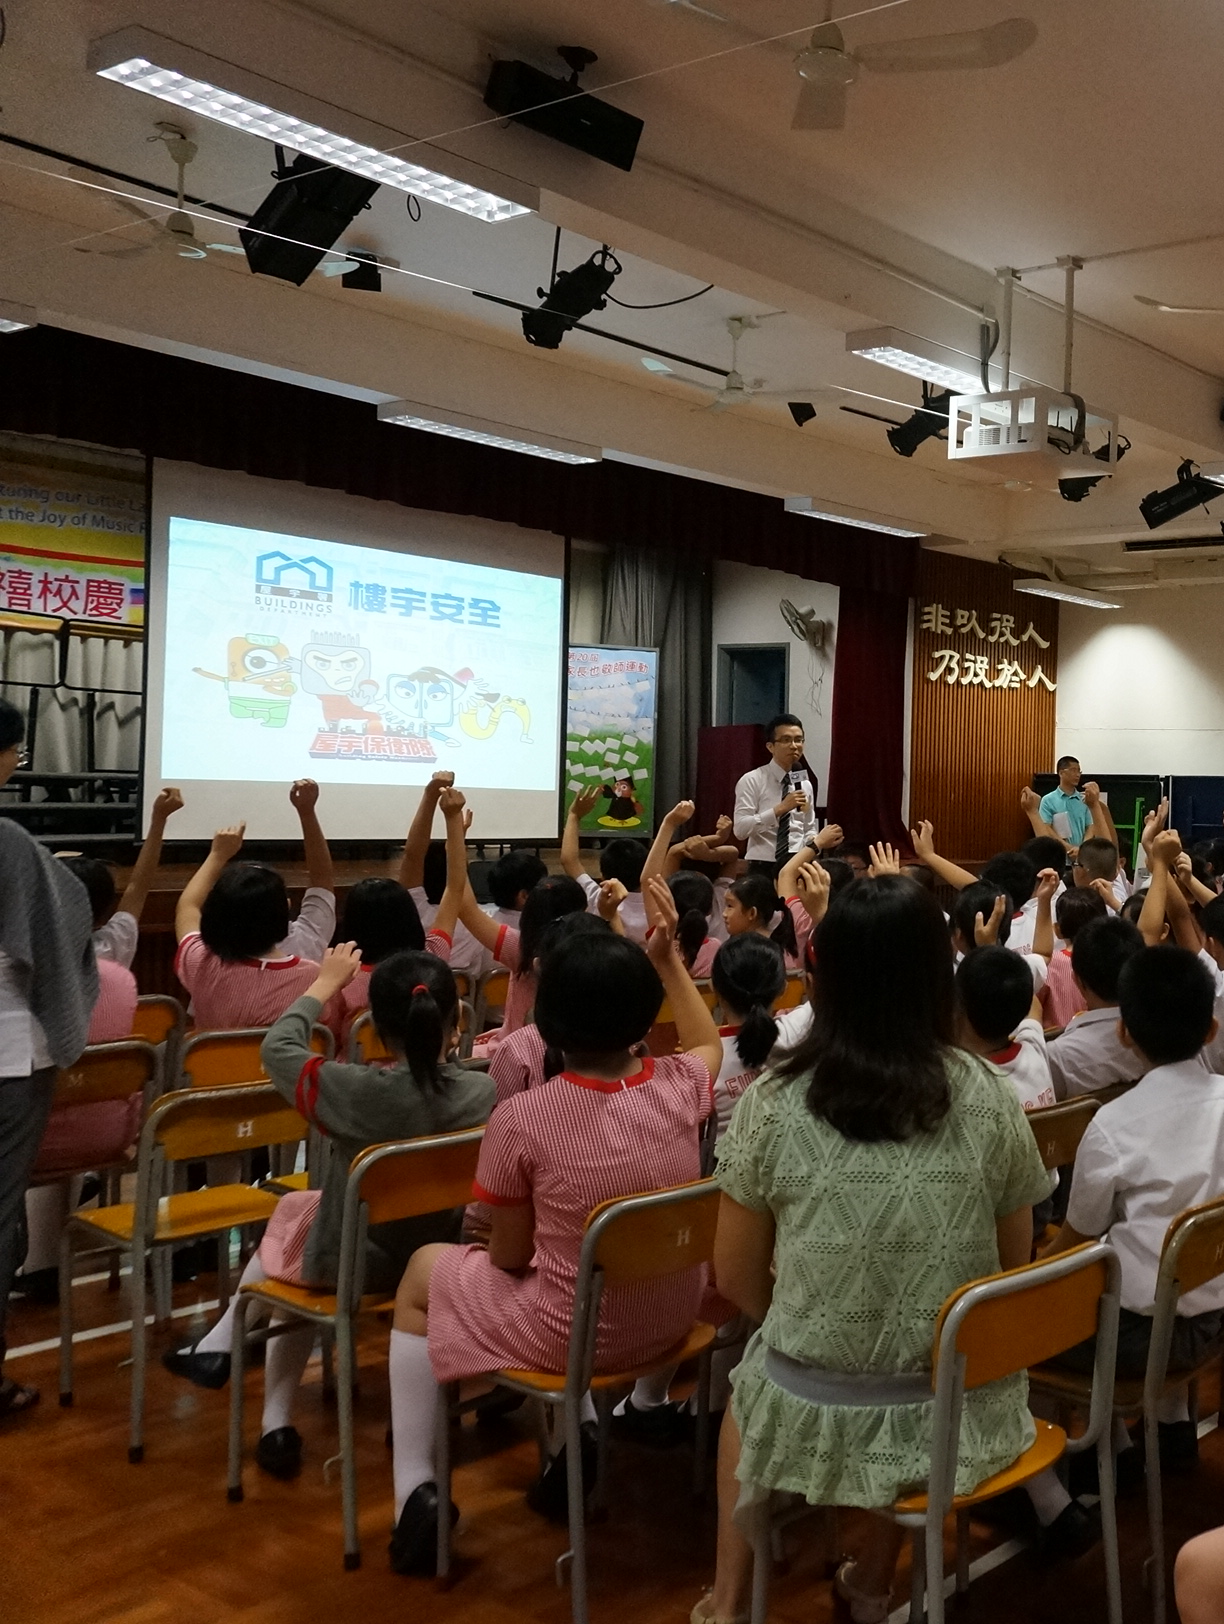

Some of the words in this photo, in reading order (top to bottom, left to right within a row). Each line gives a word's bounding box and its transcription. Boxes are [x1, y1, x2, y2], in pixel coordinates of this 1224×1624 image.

[55, 491, 82, 503] our
[8, 506, 35, 523] the
[39, 511, 67, 527] Joy
[71, 513, 88, 526] of
[92, 515, 134, 533] Music
[254, 595, 333, 614] BUILDINGS
[259, 606, 328, 618] DEPARTMENT
[348, 580, 502, 628] 樓宇安全
[927, 649, 1058, 692] 乃役於人
[309, 733, 436, 756] 屋宇保衛隊
[237, 1120, 254, 1138] H
[677, 1226, 691, 1247] H
